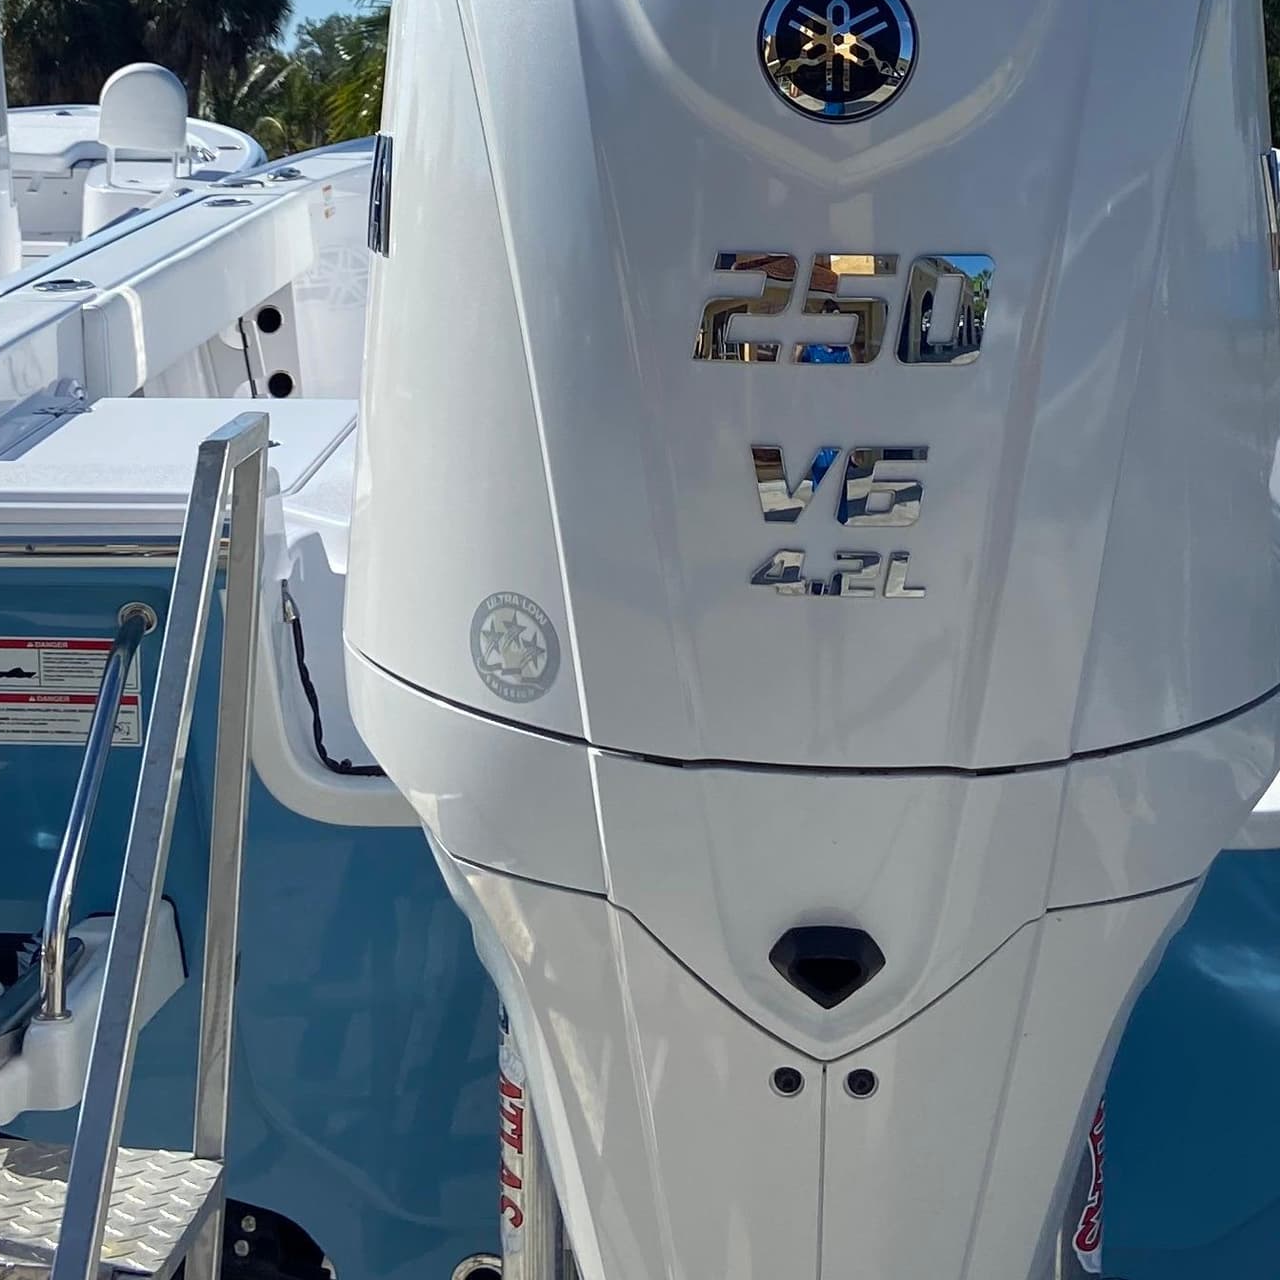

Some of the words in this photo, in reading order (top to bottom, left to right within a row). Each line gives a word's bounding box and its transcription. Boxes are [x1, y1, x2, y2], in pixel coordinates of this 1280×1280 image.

[691, 251, 997, 367] 250
[749, 444, 930, 527] V6
[749, 548, 926, 598] 4.2L
[486, 593, 520, 610] ULTRA
[522, 600, 548, 626] LOW
[35, 641, 69, 649] DANGER
[37, 695, 71, 703] DANGER
